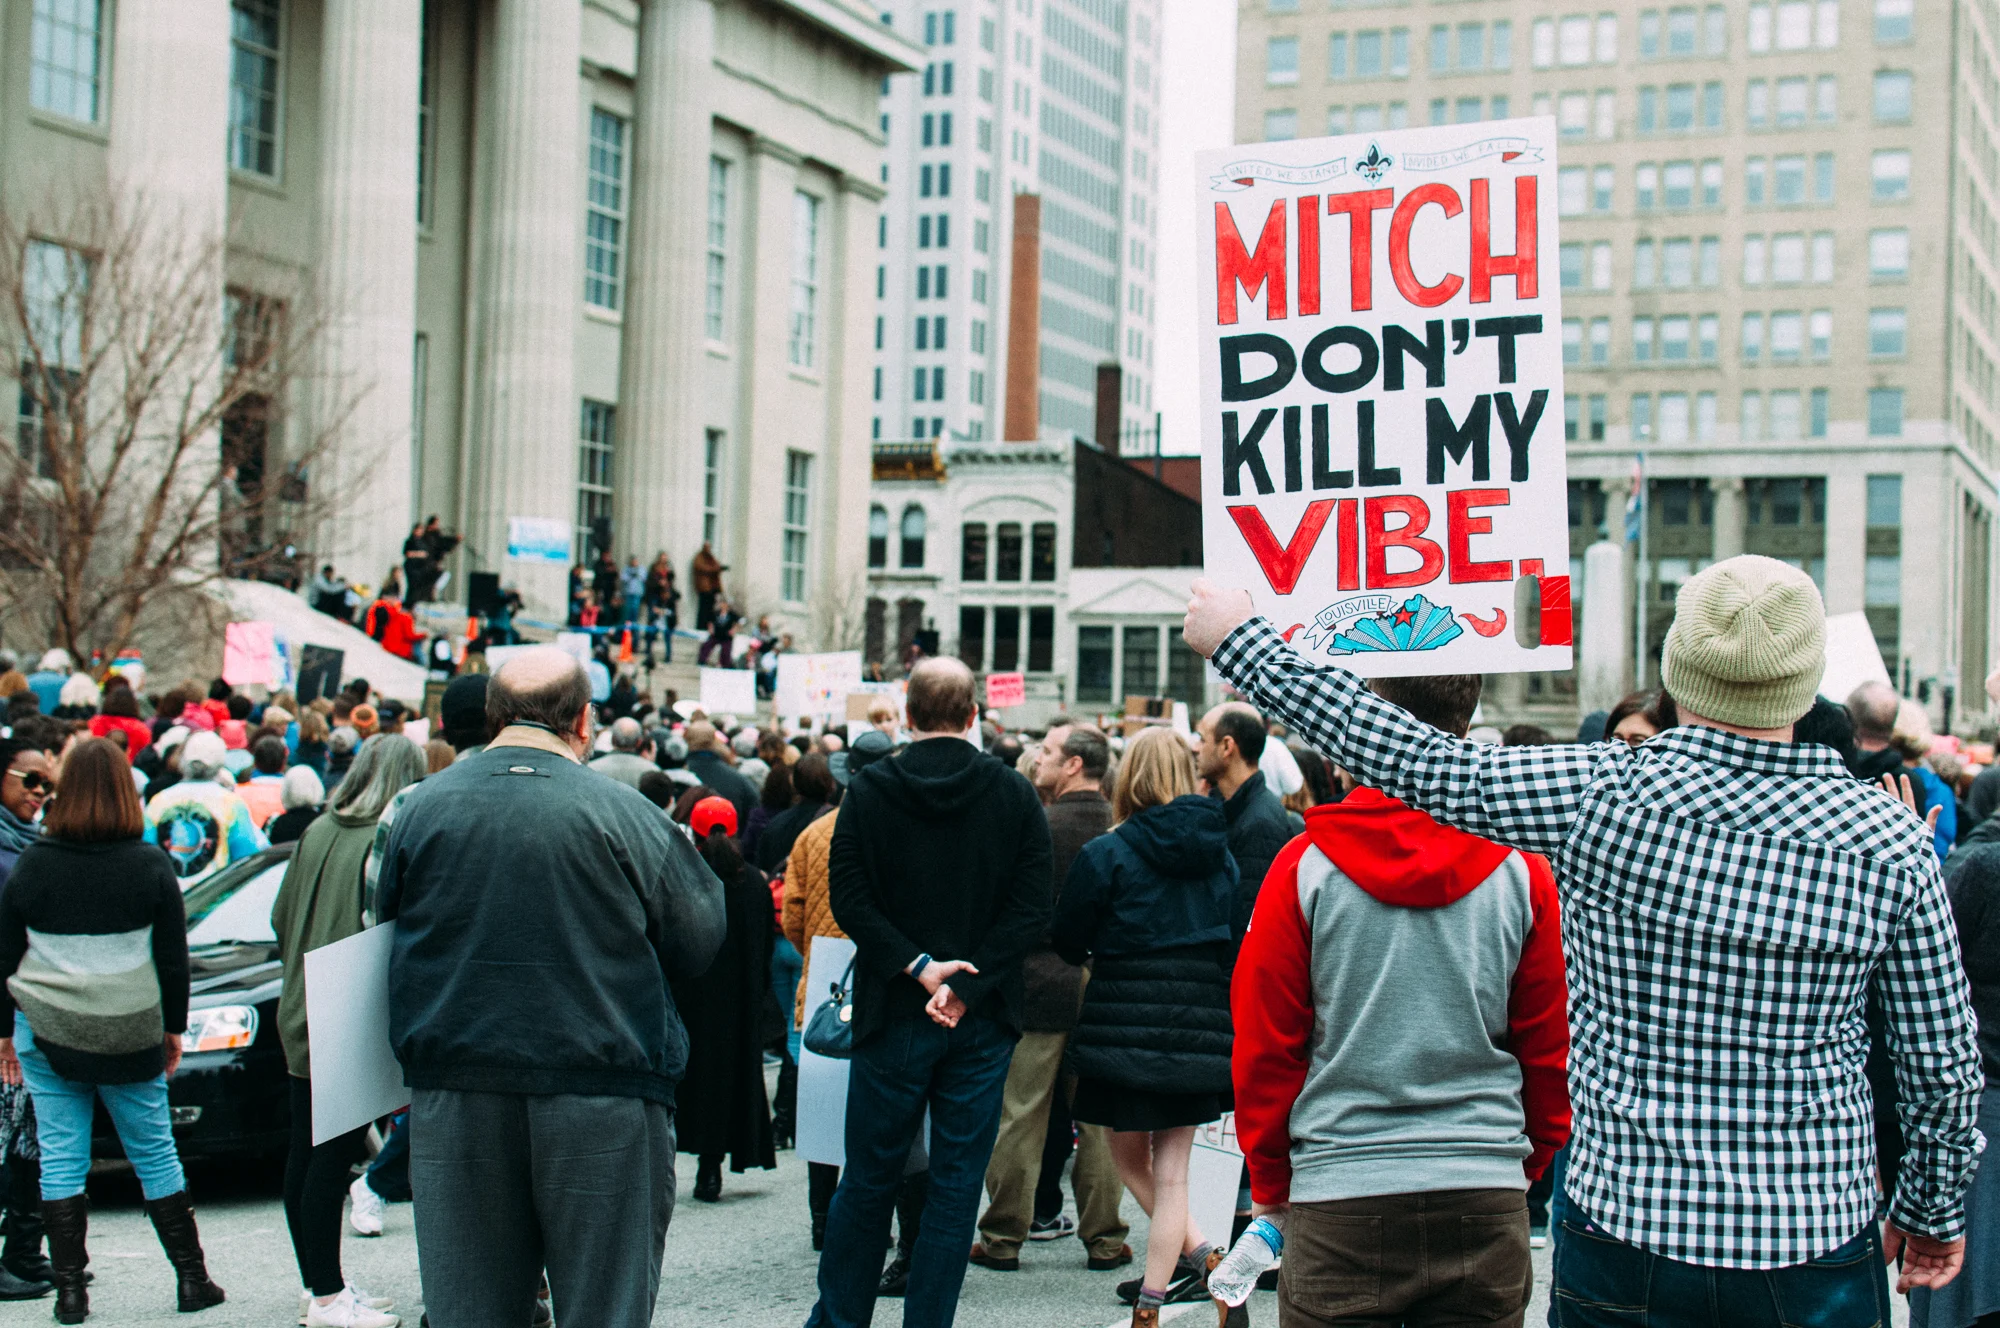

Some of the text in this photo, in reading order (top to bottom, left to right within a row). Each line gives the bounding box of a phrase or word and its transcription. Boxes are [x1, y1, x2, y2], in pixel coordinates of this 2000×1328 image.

[1229, 164, 1339, 181] UNITED WE STAND
[1408, 141, 1514, 168] DIVIDED WE FALL
[1214, 175, 1539, 325] MITCH
[1219, 314, 1543, 402] DON'T
[1221, 388, 1550, 497] KILL MY
[1225, 487, 1546, 596] VIBE.
[1319, 597, 1387, 627] LOUISVILLE
